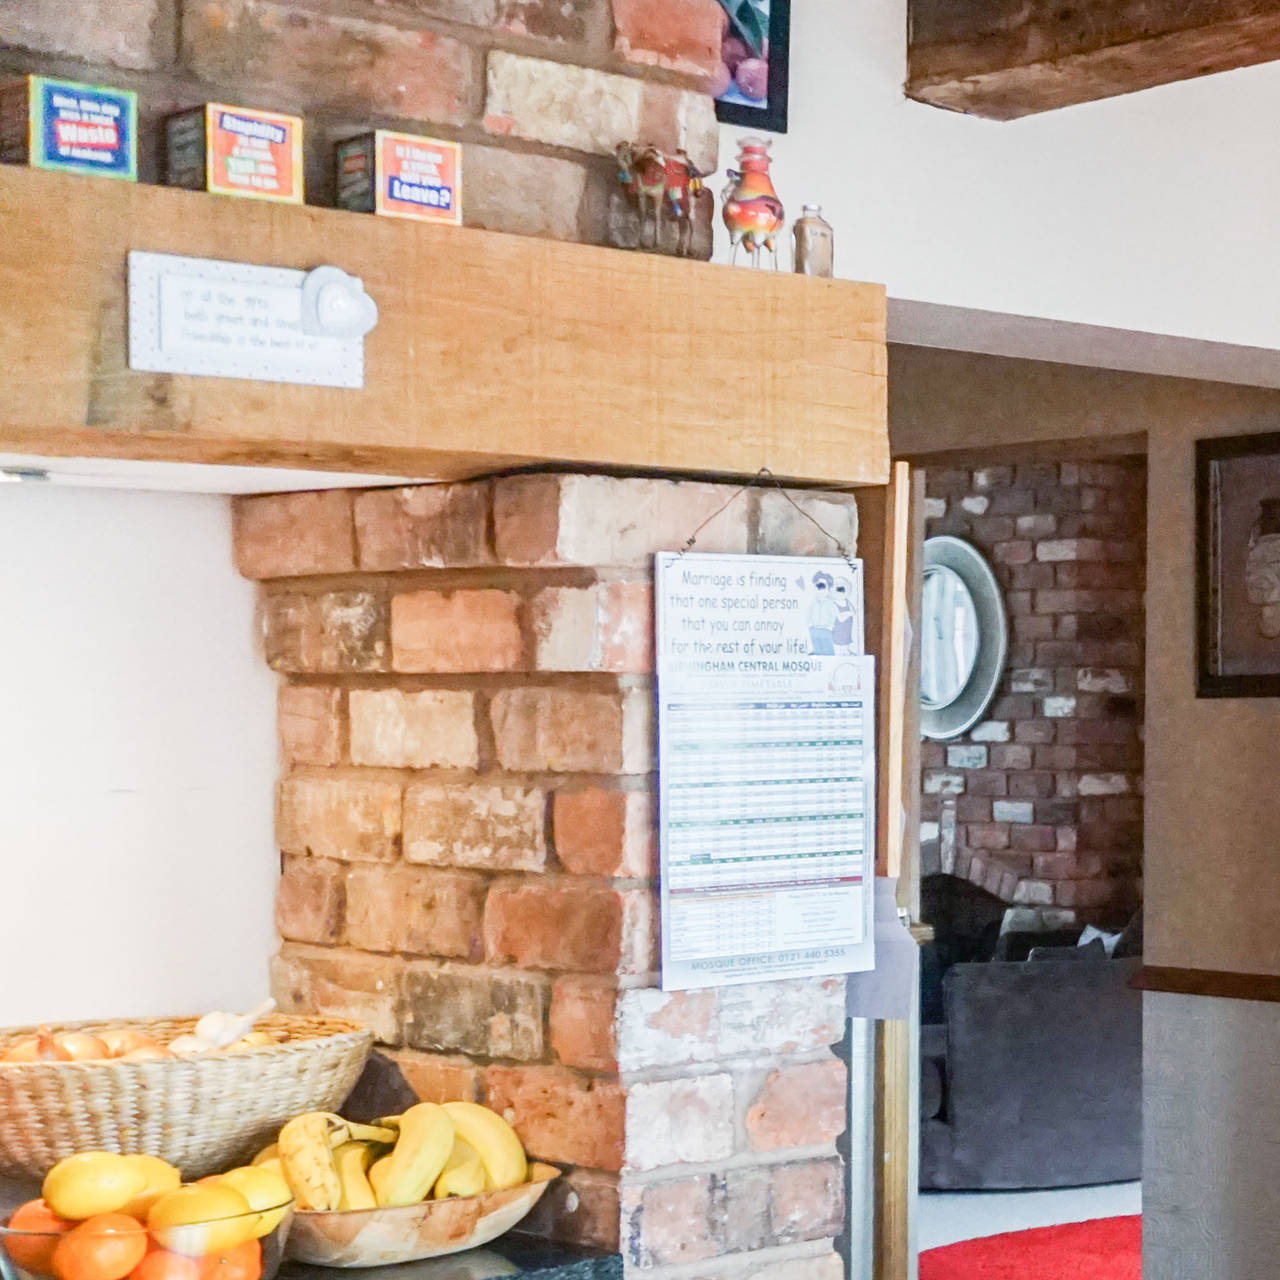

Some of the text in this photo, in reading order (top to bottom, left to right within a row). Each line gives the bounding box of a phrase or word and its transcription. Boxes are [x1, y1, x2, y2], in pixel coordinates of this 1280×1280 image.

[394, 180, 451, 206] Leave?
[682, 570, 788, 592] Marriage is finding
[670, 594, 799, 613] that one special person
[682, 617, 785, 635] that you can annoy
[671, 640, 689, 655] for
[693, 640, 712, 655] the
[716, 640, 740, 655] rest
[743, 640, 755, 655] of
[759, 642, 783, 656] your
[738, 660, 779, 672] CENTRAL
[782, 660, 824, 673] MOSQUE
[691, 958, 736, 971] MOSQUE
[778, 952, 801, 963] 0121
